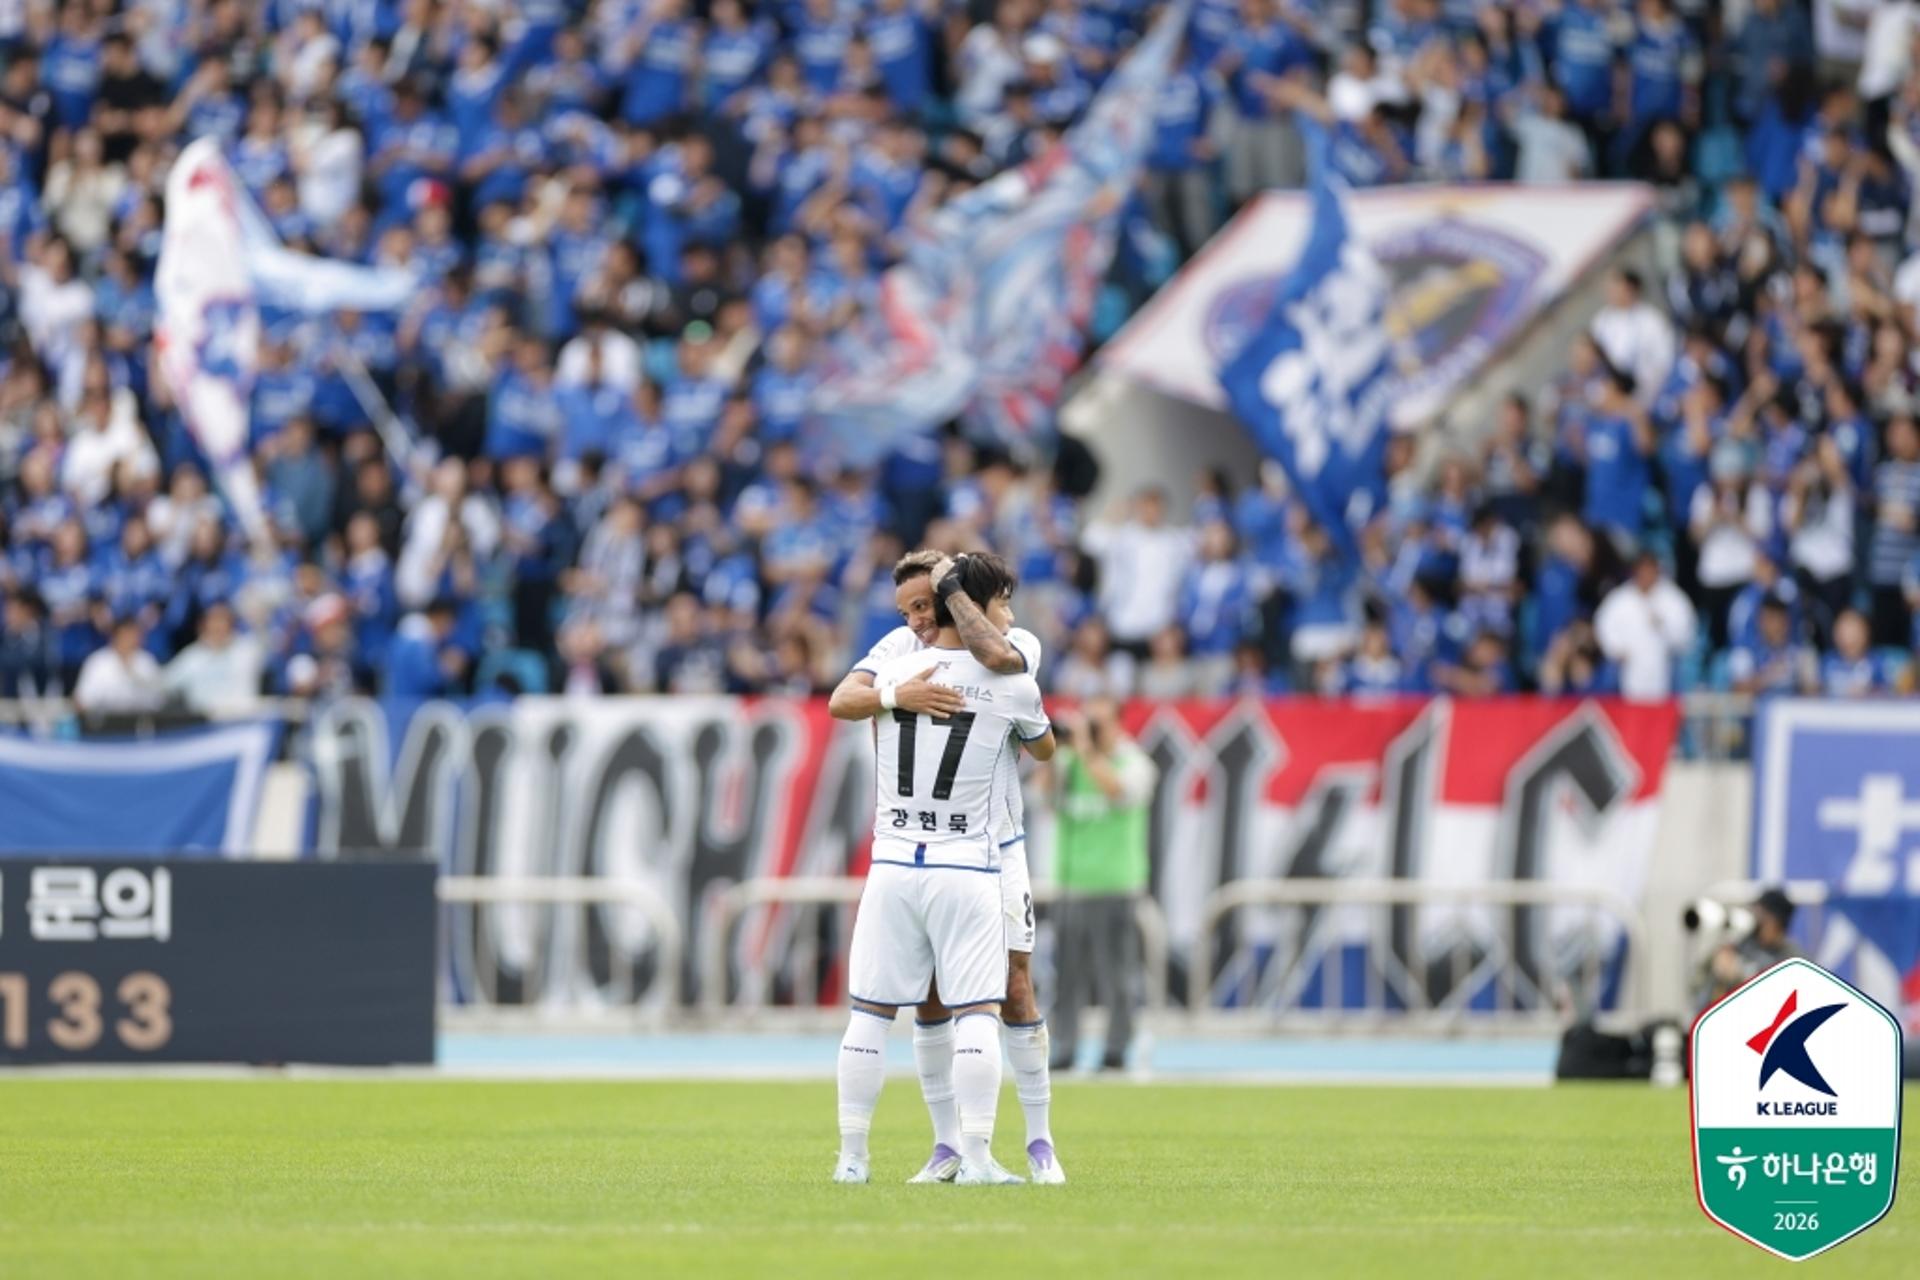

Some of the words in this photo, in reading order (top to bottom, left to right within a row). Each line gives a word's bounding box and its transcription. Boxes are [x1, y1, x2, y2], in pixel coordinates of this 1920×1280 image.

[892, 707, 977, 801] 17
[890, 808, 969, 834] 강현묵
[28, 866, 171, 941] 문의
[0, 971, 173, 1050] 133
